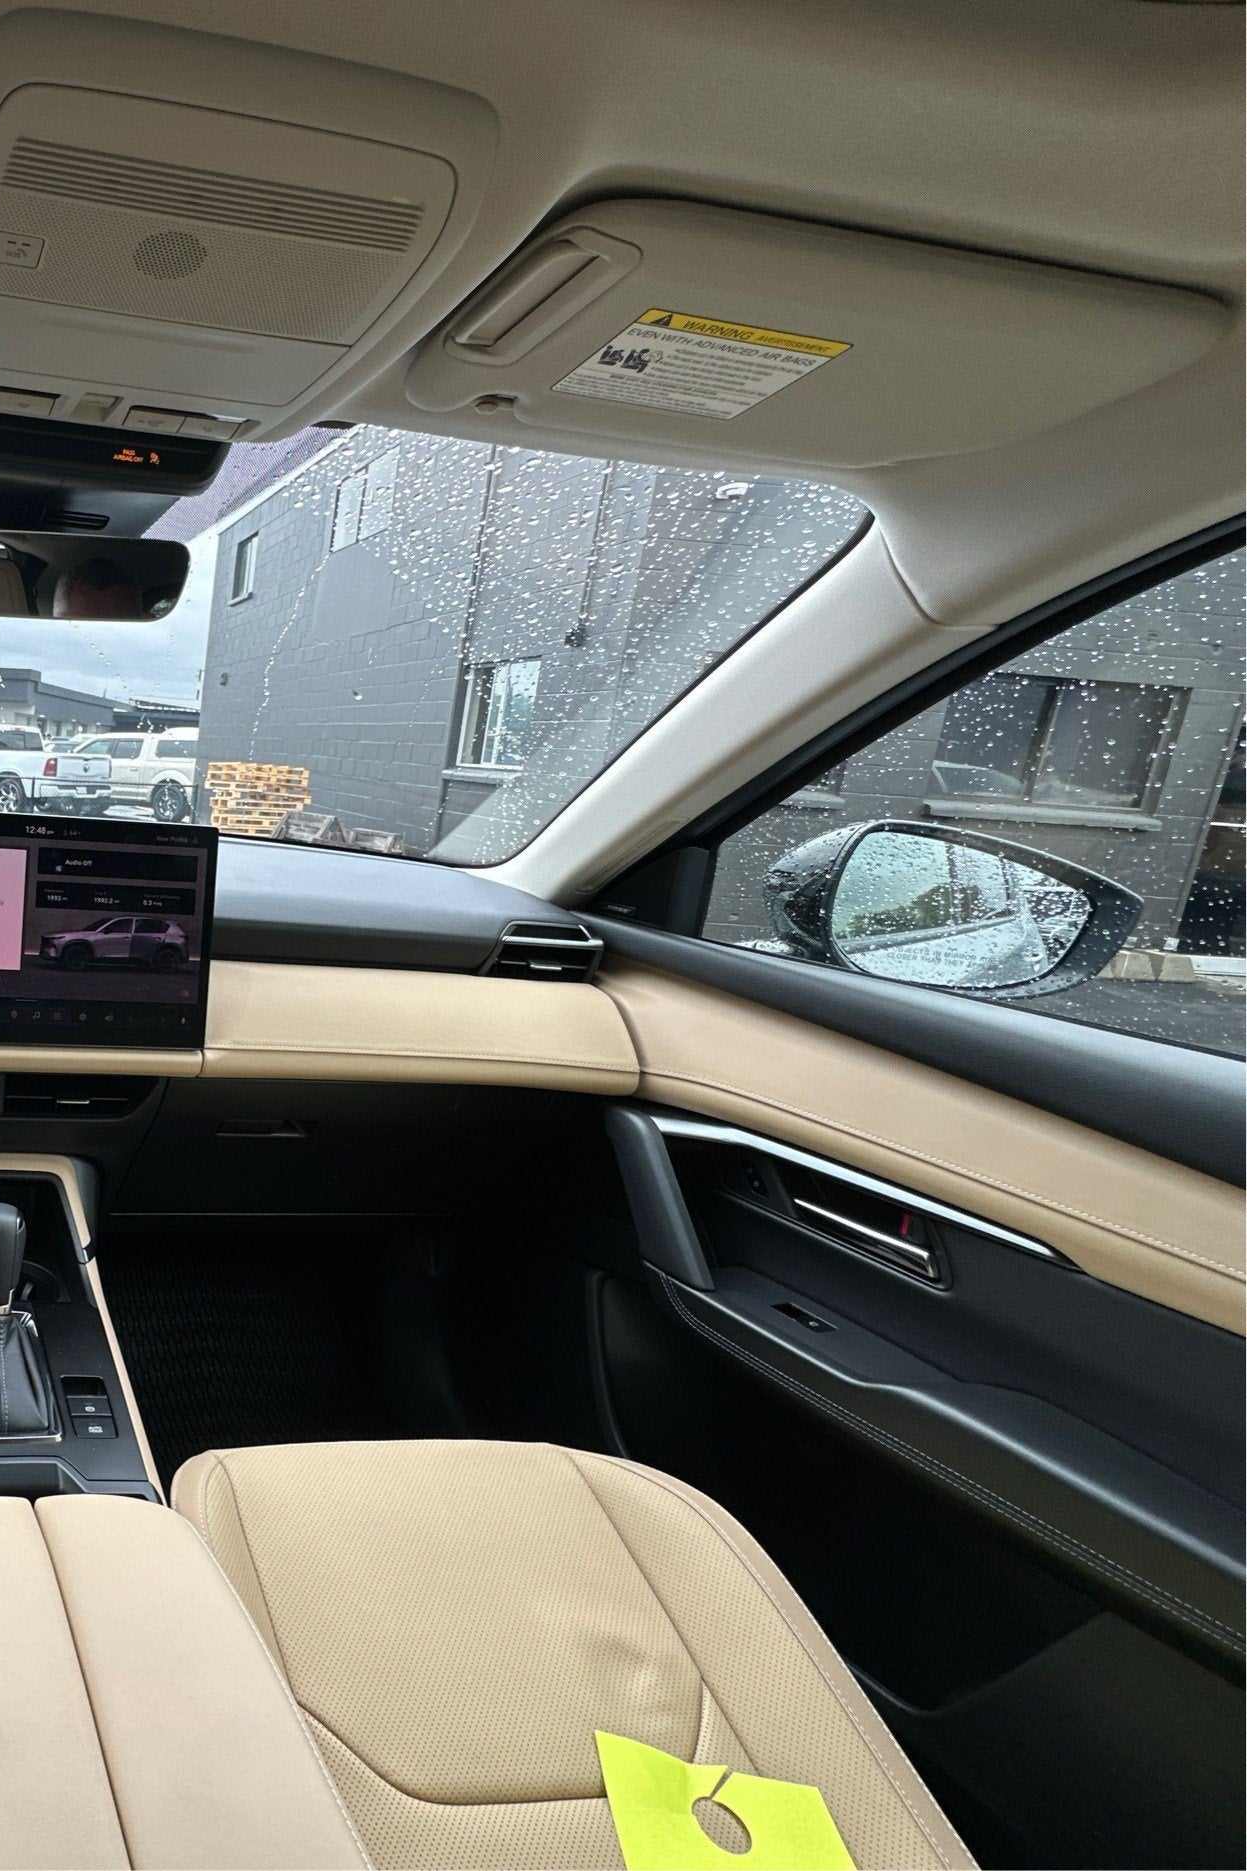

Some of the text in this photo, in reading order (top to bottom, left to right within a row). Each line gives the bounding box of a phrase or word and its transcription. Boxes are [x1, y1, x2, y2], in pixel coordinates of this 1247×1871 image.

[683, 320, 754, 340] WARNING
[627, 328, 817, 367] EVEN WITH ADVANCED AIR BAGS
[25, 825, 47, 836] 12:48
[64, 858, 82, 866] Audio
